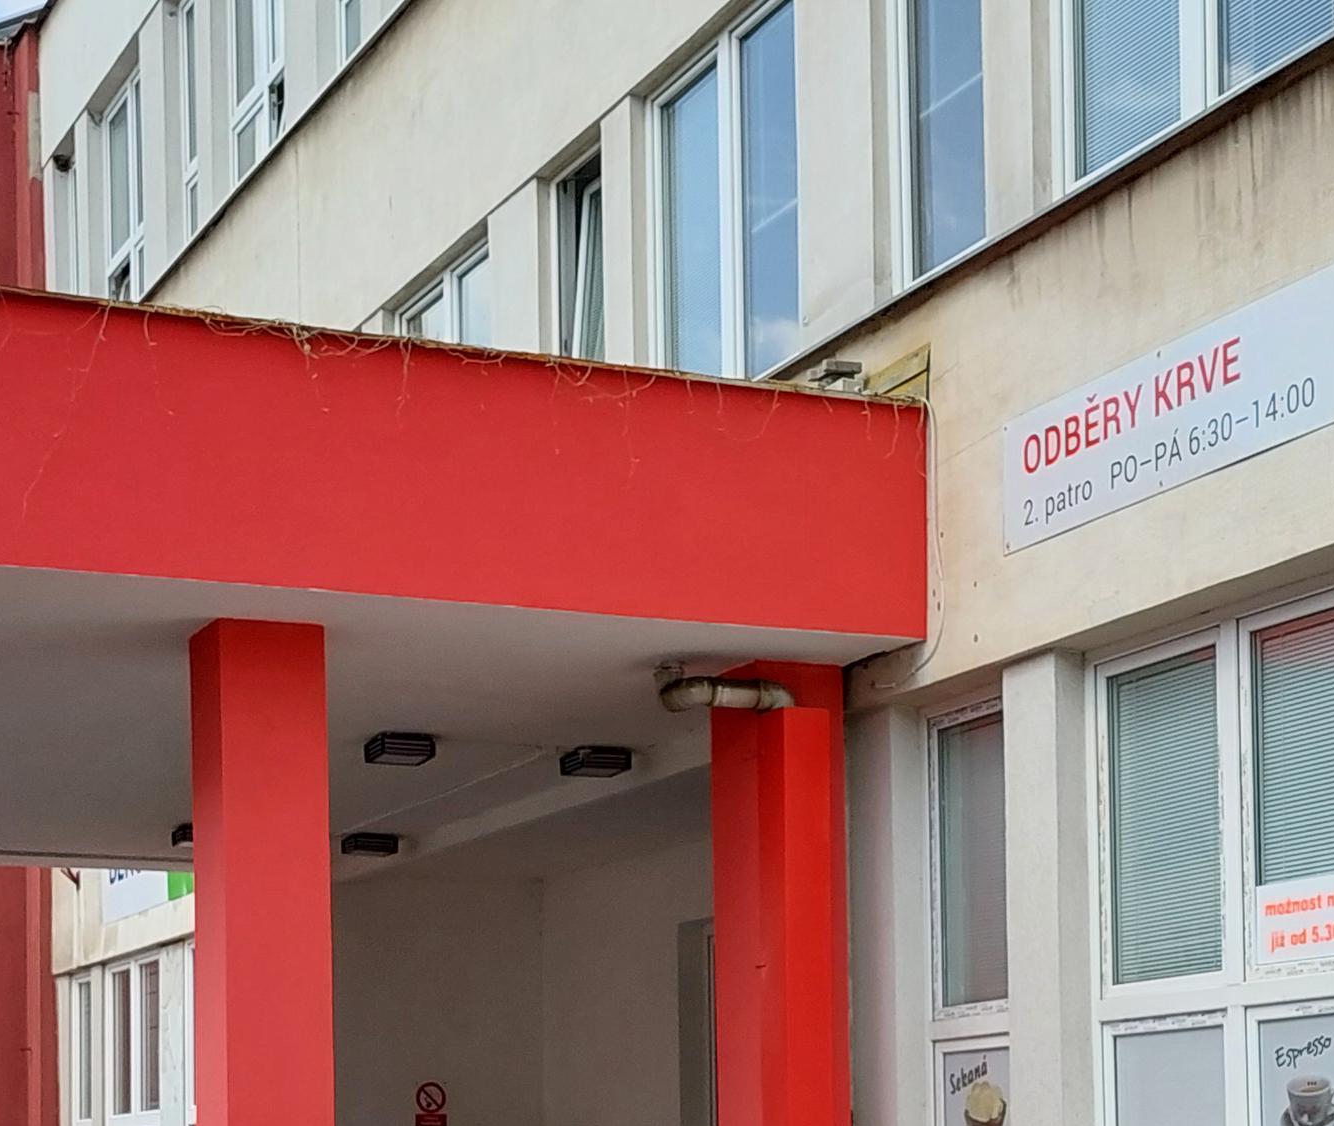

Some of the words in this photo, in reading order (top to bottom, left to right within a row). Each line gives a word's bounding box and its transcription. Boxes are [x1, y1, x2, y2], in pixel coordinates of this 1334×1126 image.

[1022, 383, 1143, 475] ODBĚRY
[1154, 336, 1243, 418] KRVE
[1023, 499, 1040, 527] 2.
[1044, 477, 1094, 525] patro
[1265, 895, 1323, 917] možnost
[1291, 928, 1307, 946] od
[1274, 1035, 1332, 1070] Espresso
[950, 1054, 988, 1095] Sekaná
